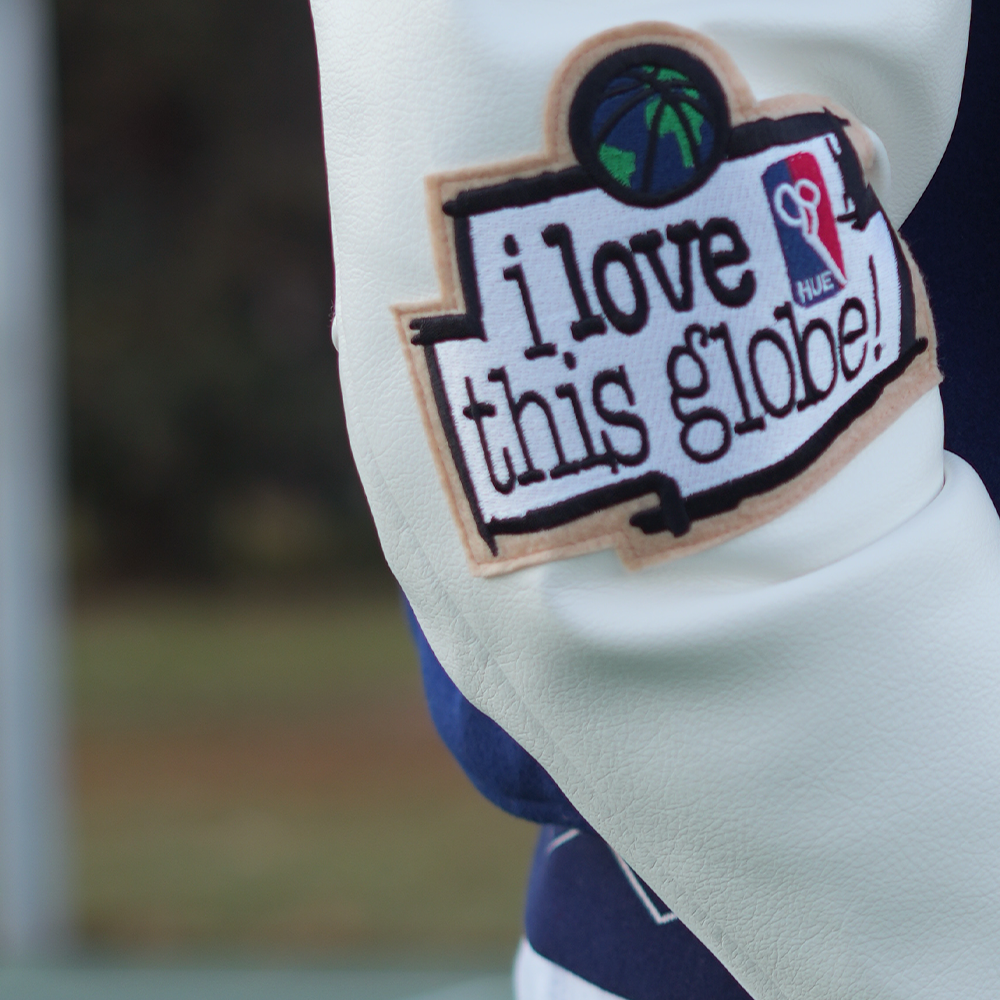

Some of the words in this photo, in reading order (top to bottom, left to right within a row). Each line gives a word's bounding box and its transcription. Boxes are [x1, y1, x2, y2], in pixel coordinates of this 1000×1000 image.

[504, 233, 557, 359] i
[541, 216, 757, 342] love
[797, 269, 835, 303] HUE
[463, 351, 651, 495] this
[667, 254, 884, 463] globe!
